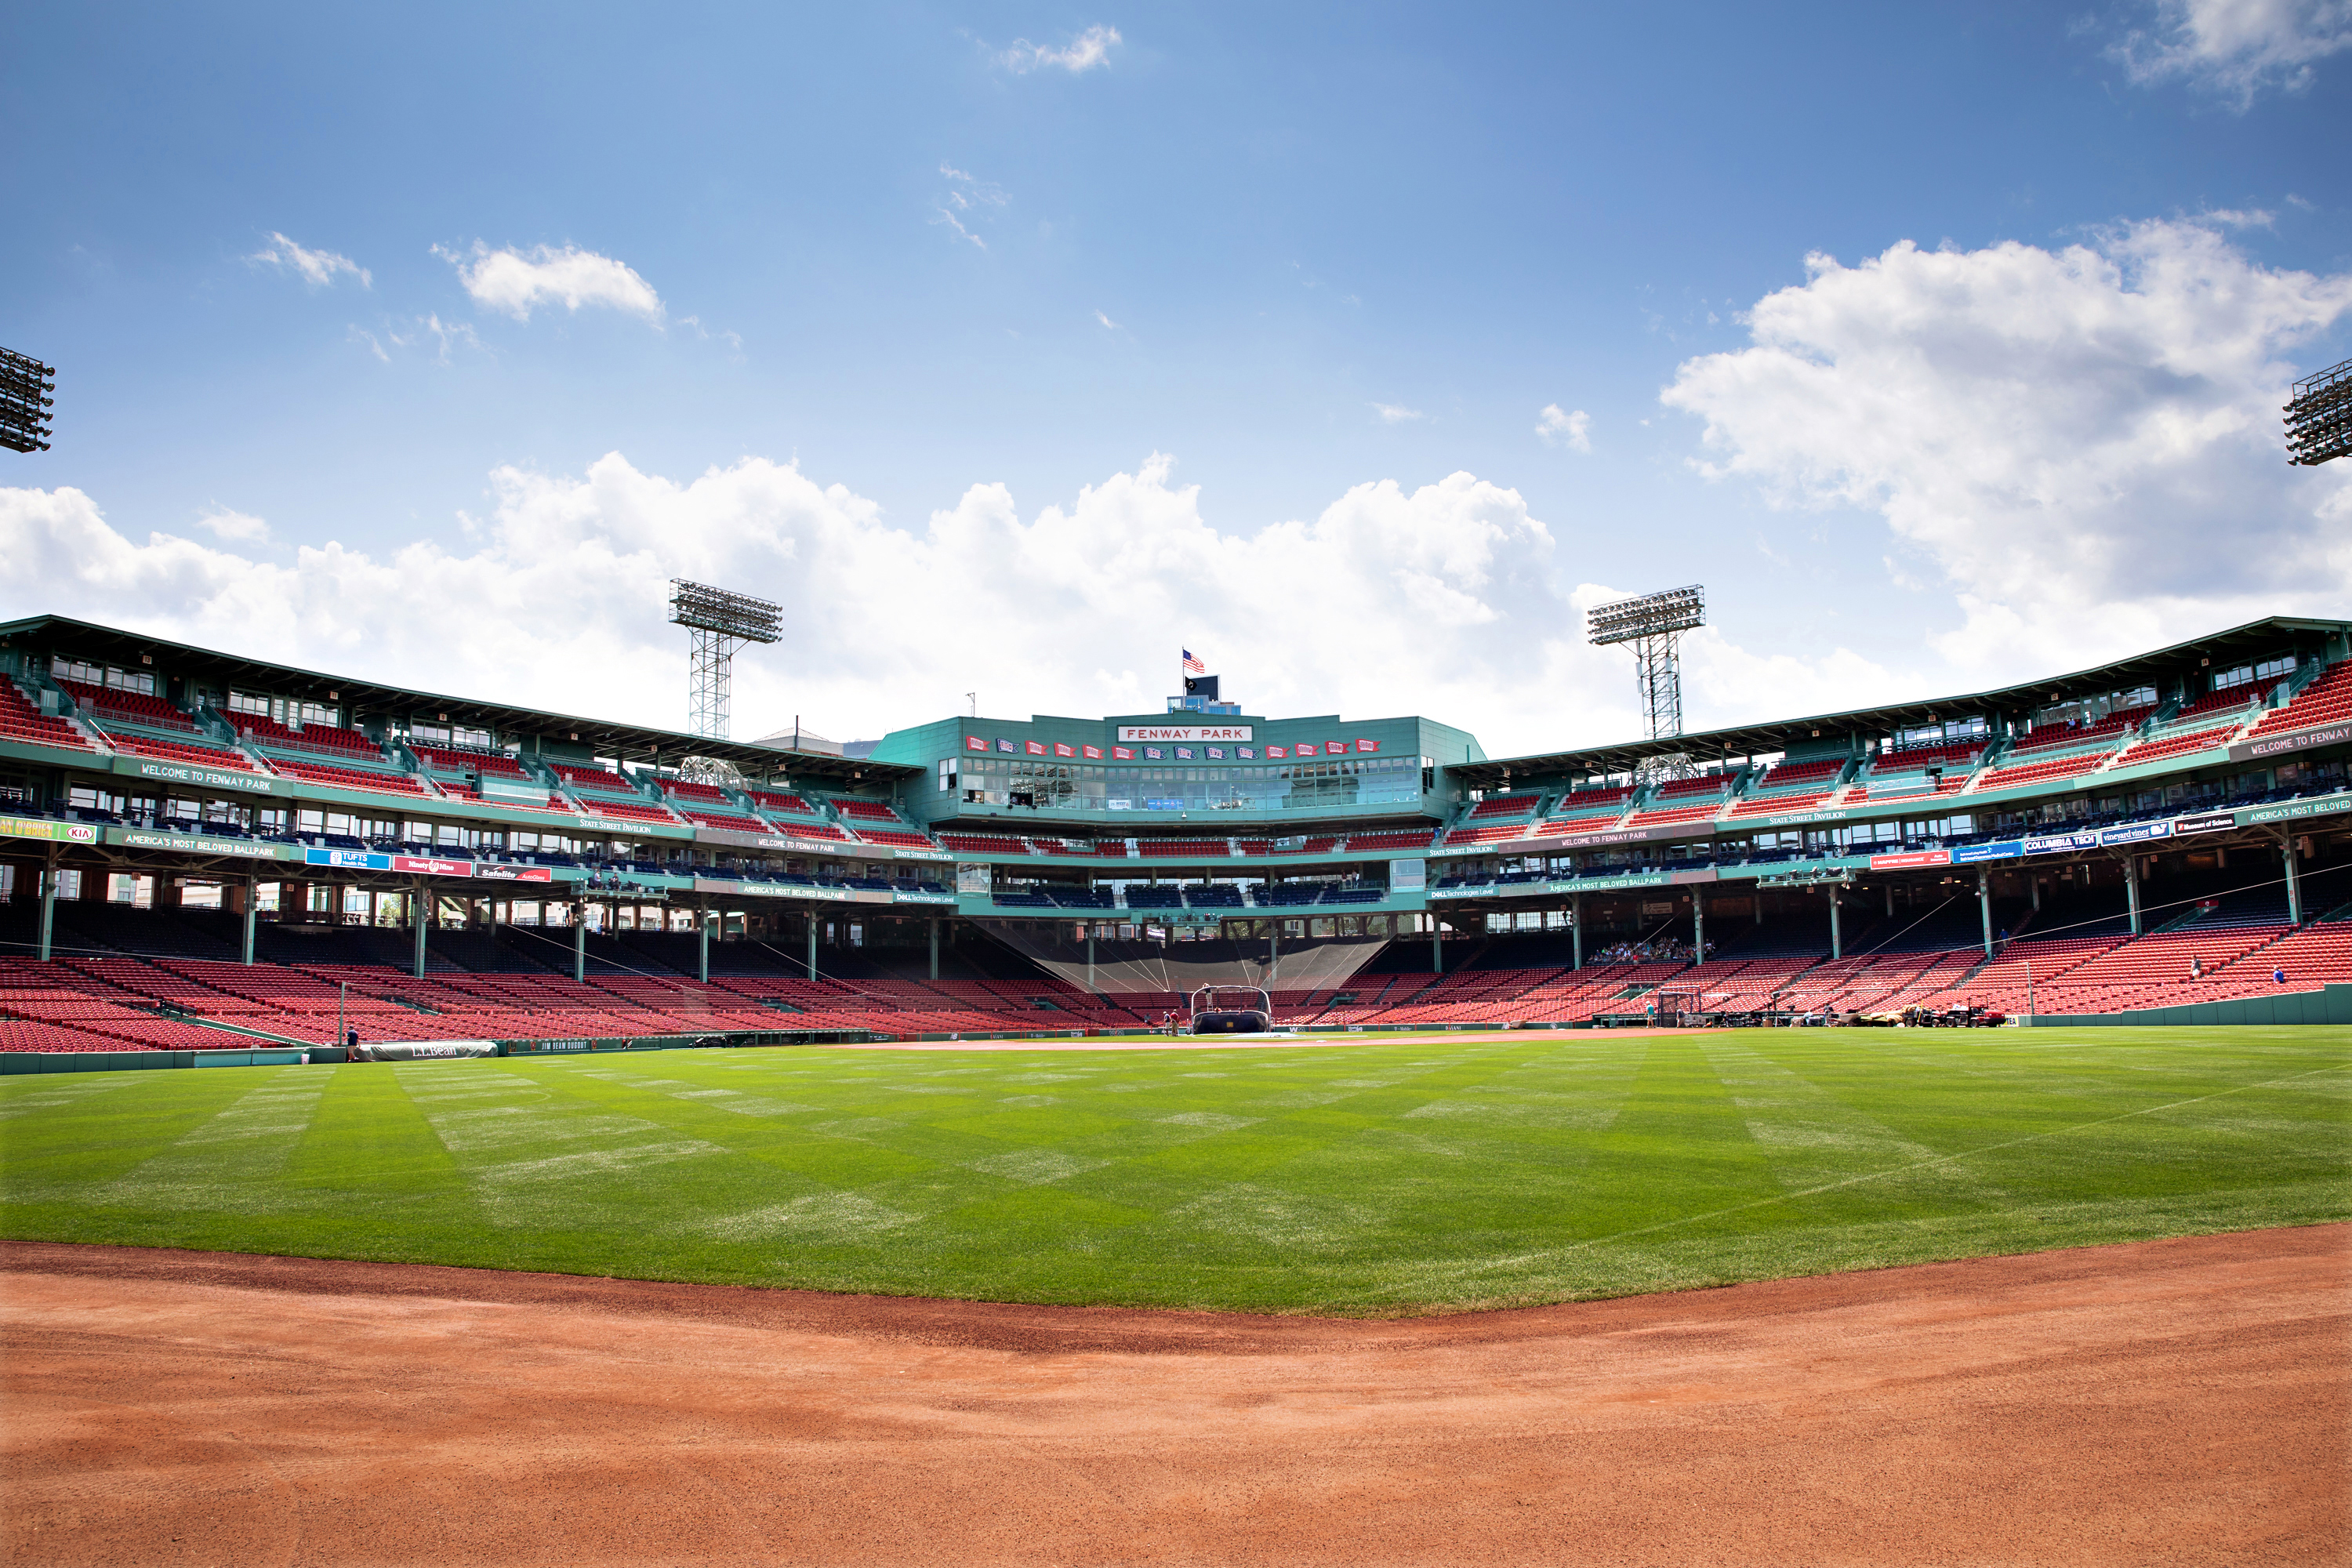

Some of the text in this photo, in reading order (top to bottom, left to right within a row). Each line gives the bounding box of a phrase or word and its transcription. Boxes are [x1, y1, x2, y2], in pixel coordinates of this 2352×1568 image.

[1127, 729, 1243, 738] FENWAY PARK
[2251, 728, 2349, 754] WELCOME TO FENWAY
[142, 764, 271, 791] WELCOME TO FENWAY PARK
[1814, 811, 1846, 820] PAVILION
[2251, 800, 2350, 821] AMERICA'S MOST BELOVED
[16, 820, 53, 837] O'BRIEN
[580, 819, 651, 833] STATE STREET PAVILION
[72, 829, 89, 838] KIA
[2104, 831, 2131, 841] vineyard
[126, 835, 274, 856] AMERICA'S MOST BELOVED BALLPARK
[758, 838, 785, 848] WELCOME
[797, 842, 819, 851] FENWAY
[1562, 837, 1590, 846] WELCOME
[1602, 834, 1627, 842] FENWAY
[2026, 835, 2095, 850] COLUMBIA TECH
[343, 853, 367, 862] TUFTS
[911, 851, 928, 859] STREET
[408, 861, 428, 869] Ninety
[482, 870, 516, 878] Safelite
[1550, 883, 1580, 892] AMERICA'S
[1600, 880, 1627, 888] BELOVED
[1629, 877, 1662, 886] BALLPARK
[744, 886, 774, 894] AMERICA'S
[817, 891, 845, 899] BALLPARK
[912, 895, 941, 903] Technologies
[412, 1045, 457, 1057] L.L.Bean
